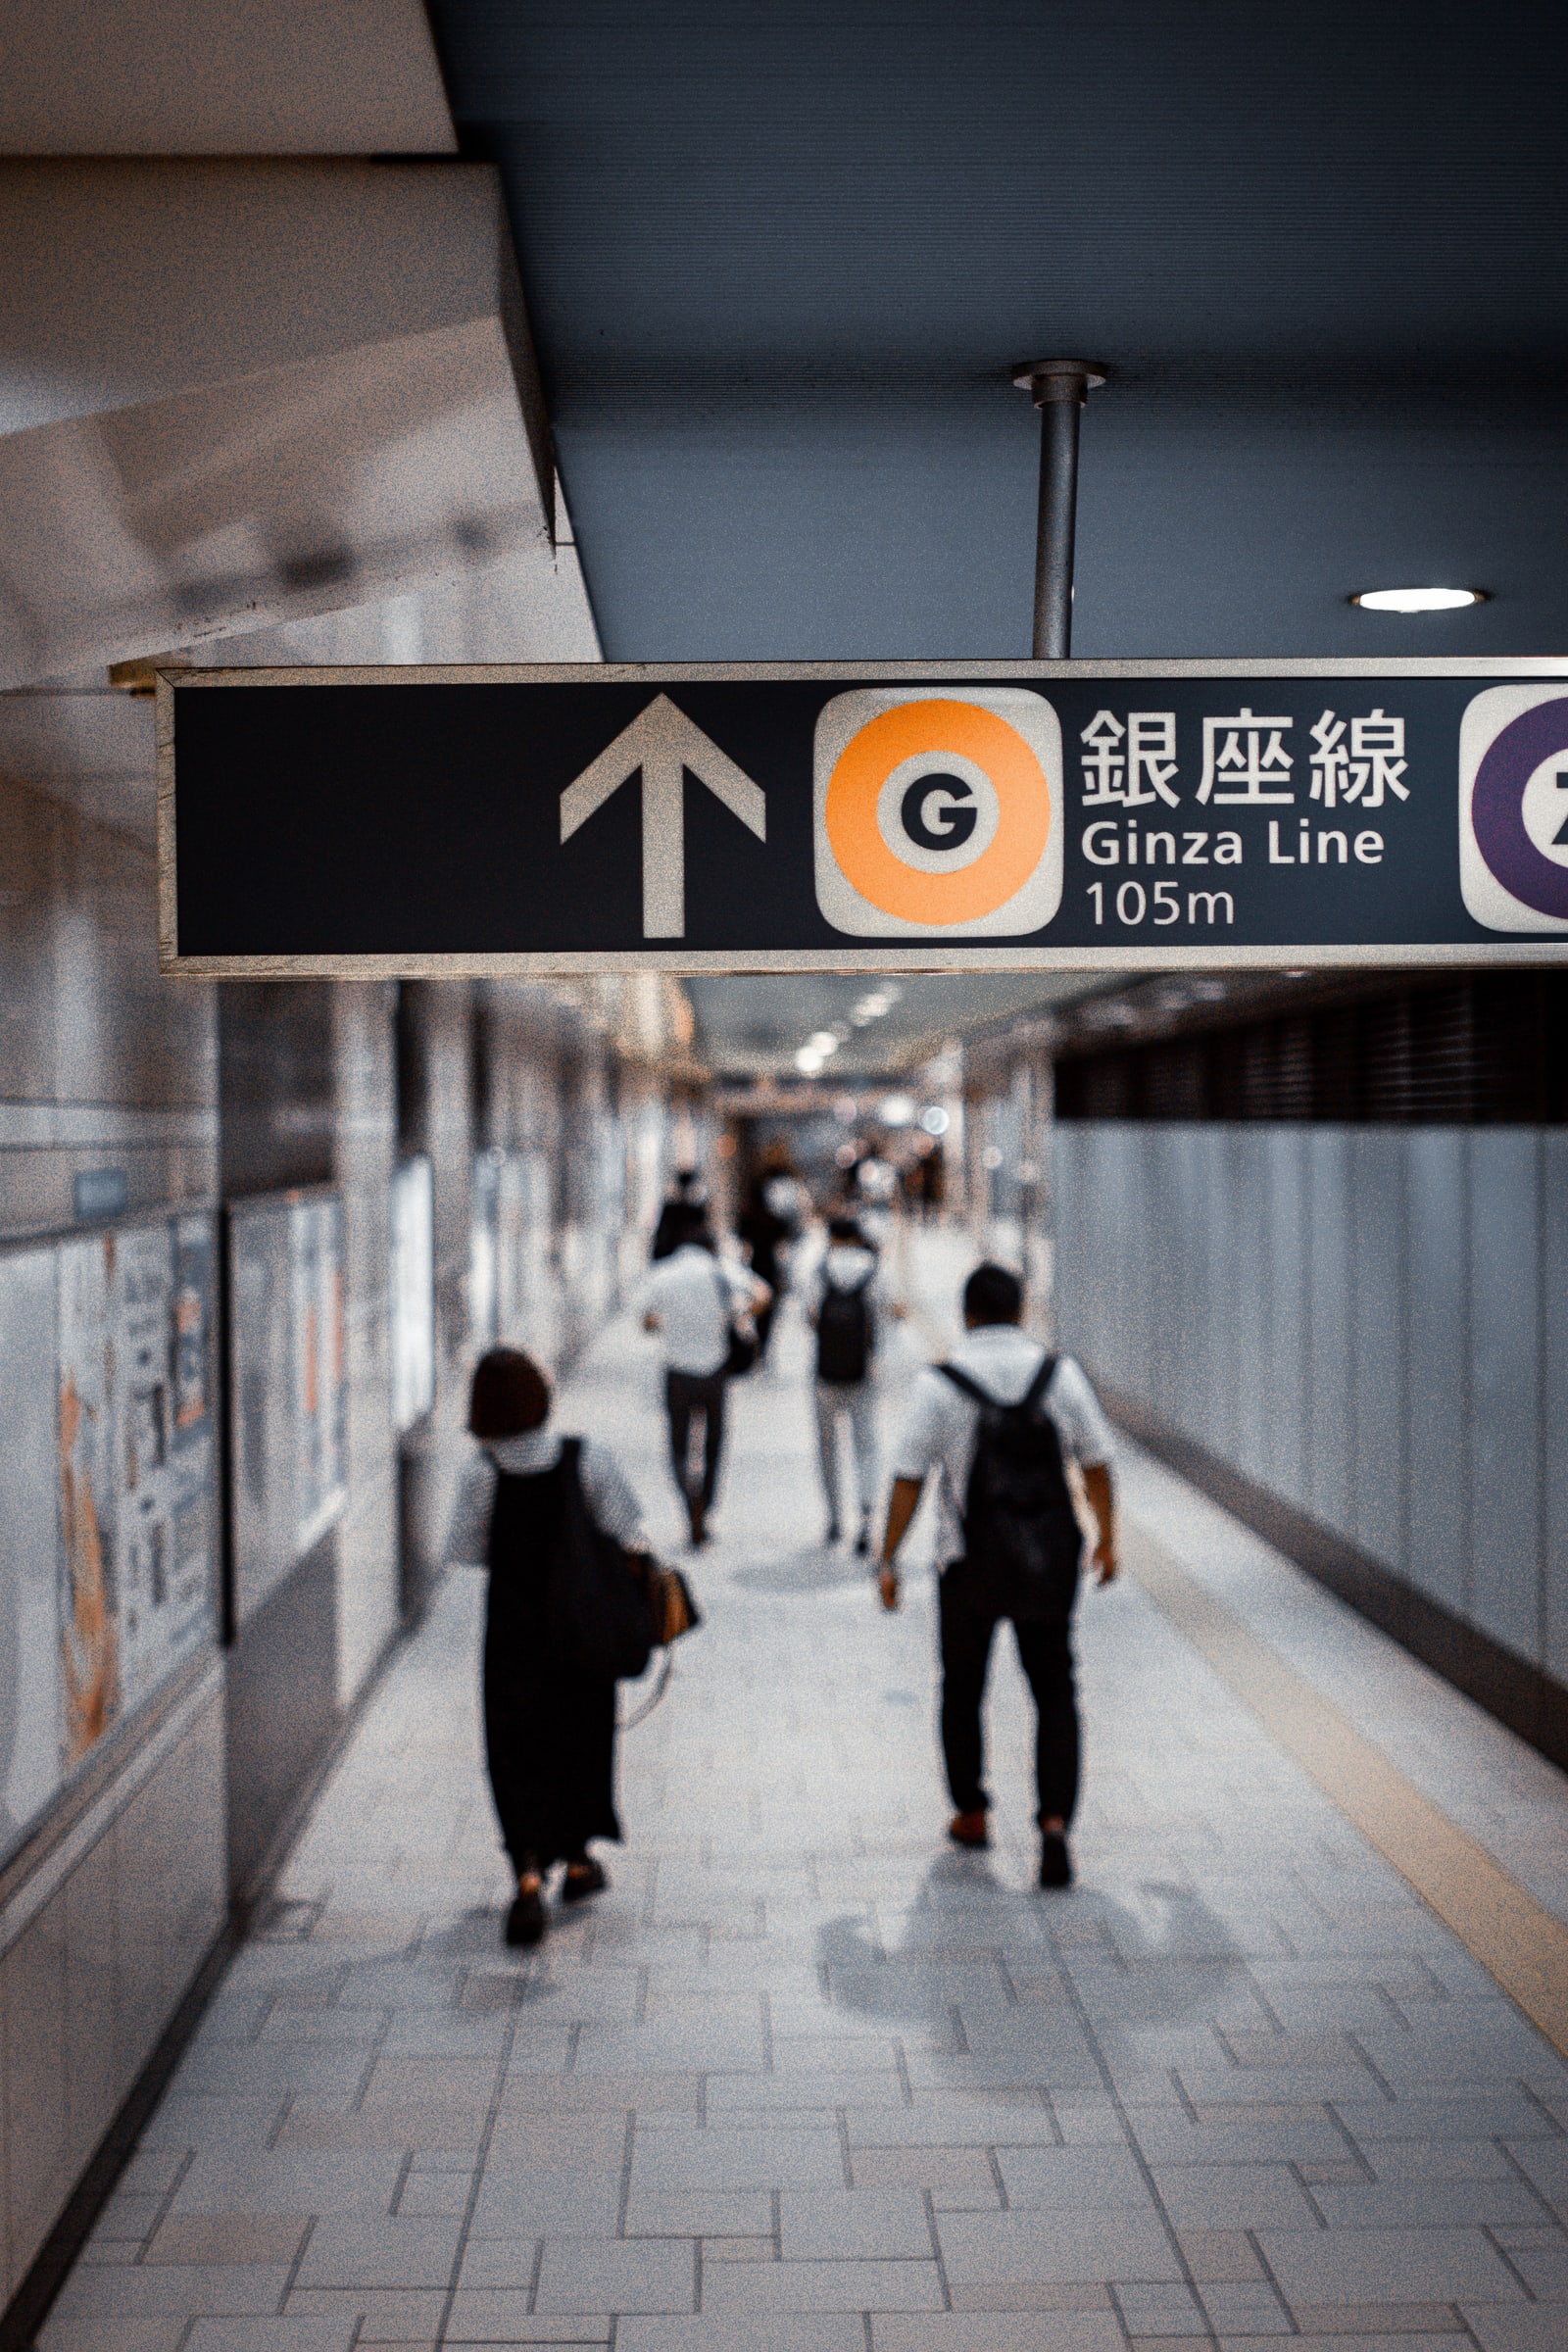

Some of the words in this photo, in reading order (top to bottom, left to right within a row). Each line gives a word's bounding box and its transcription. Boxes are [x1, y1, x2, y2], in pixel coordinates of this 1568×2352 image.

[1080, 707, 1411, 808] 銀座線
[900, 772, 978, 852] G
[1081, 818, 1243, 865] Ginza
[1268, 817, 1385, 864] Line
[1086, 880, 1234, 925] 105m
